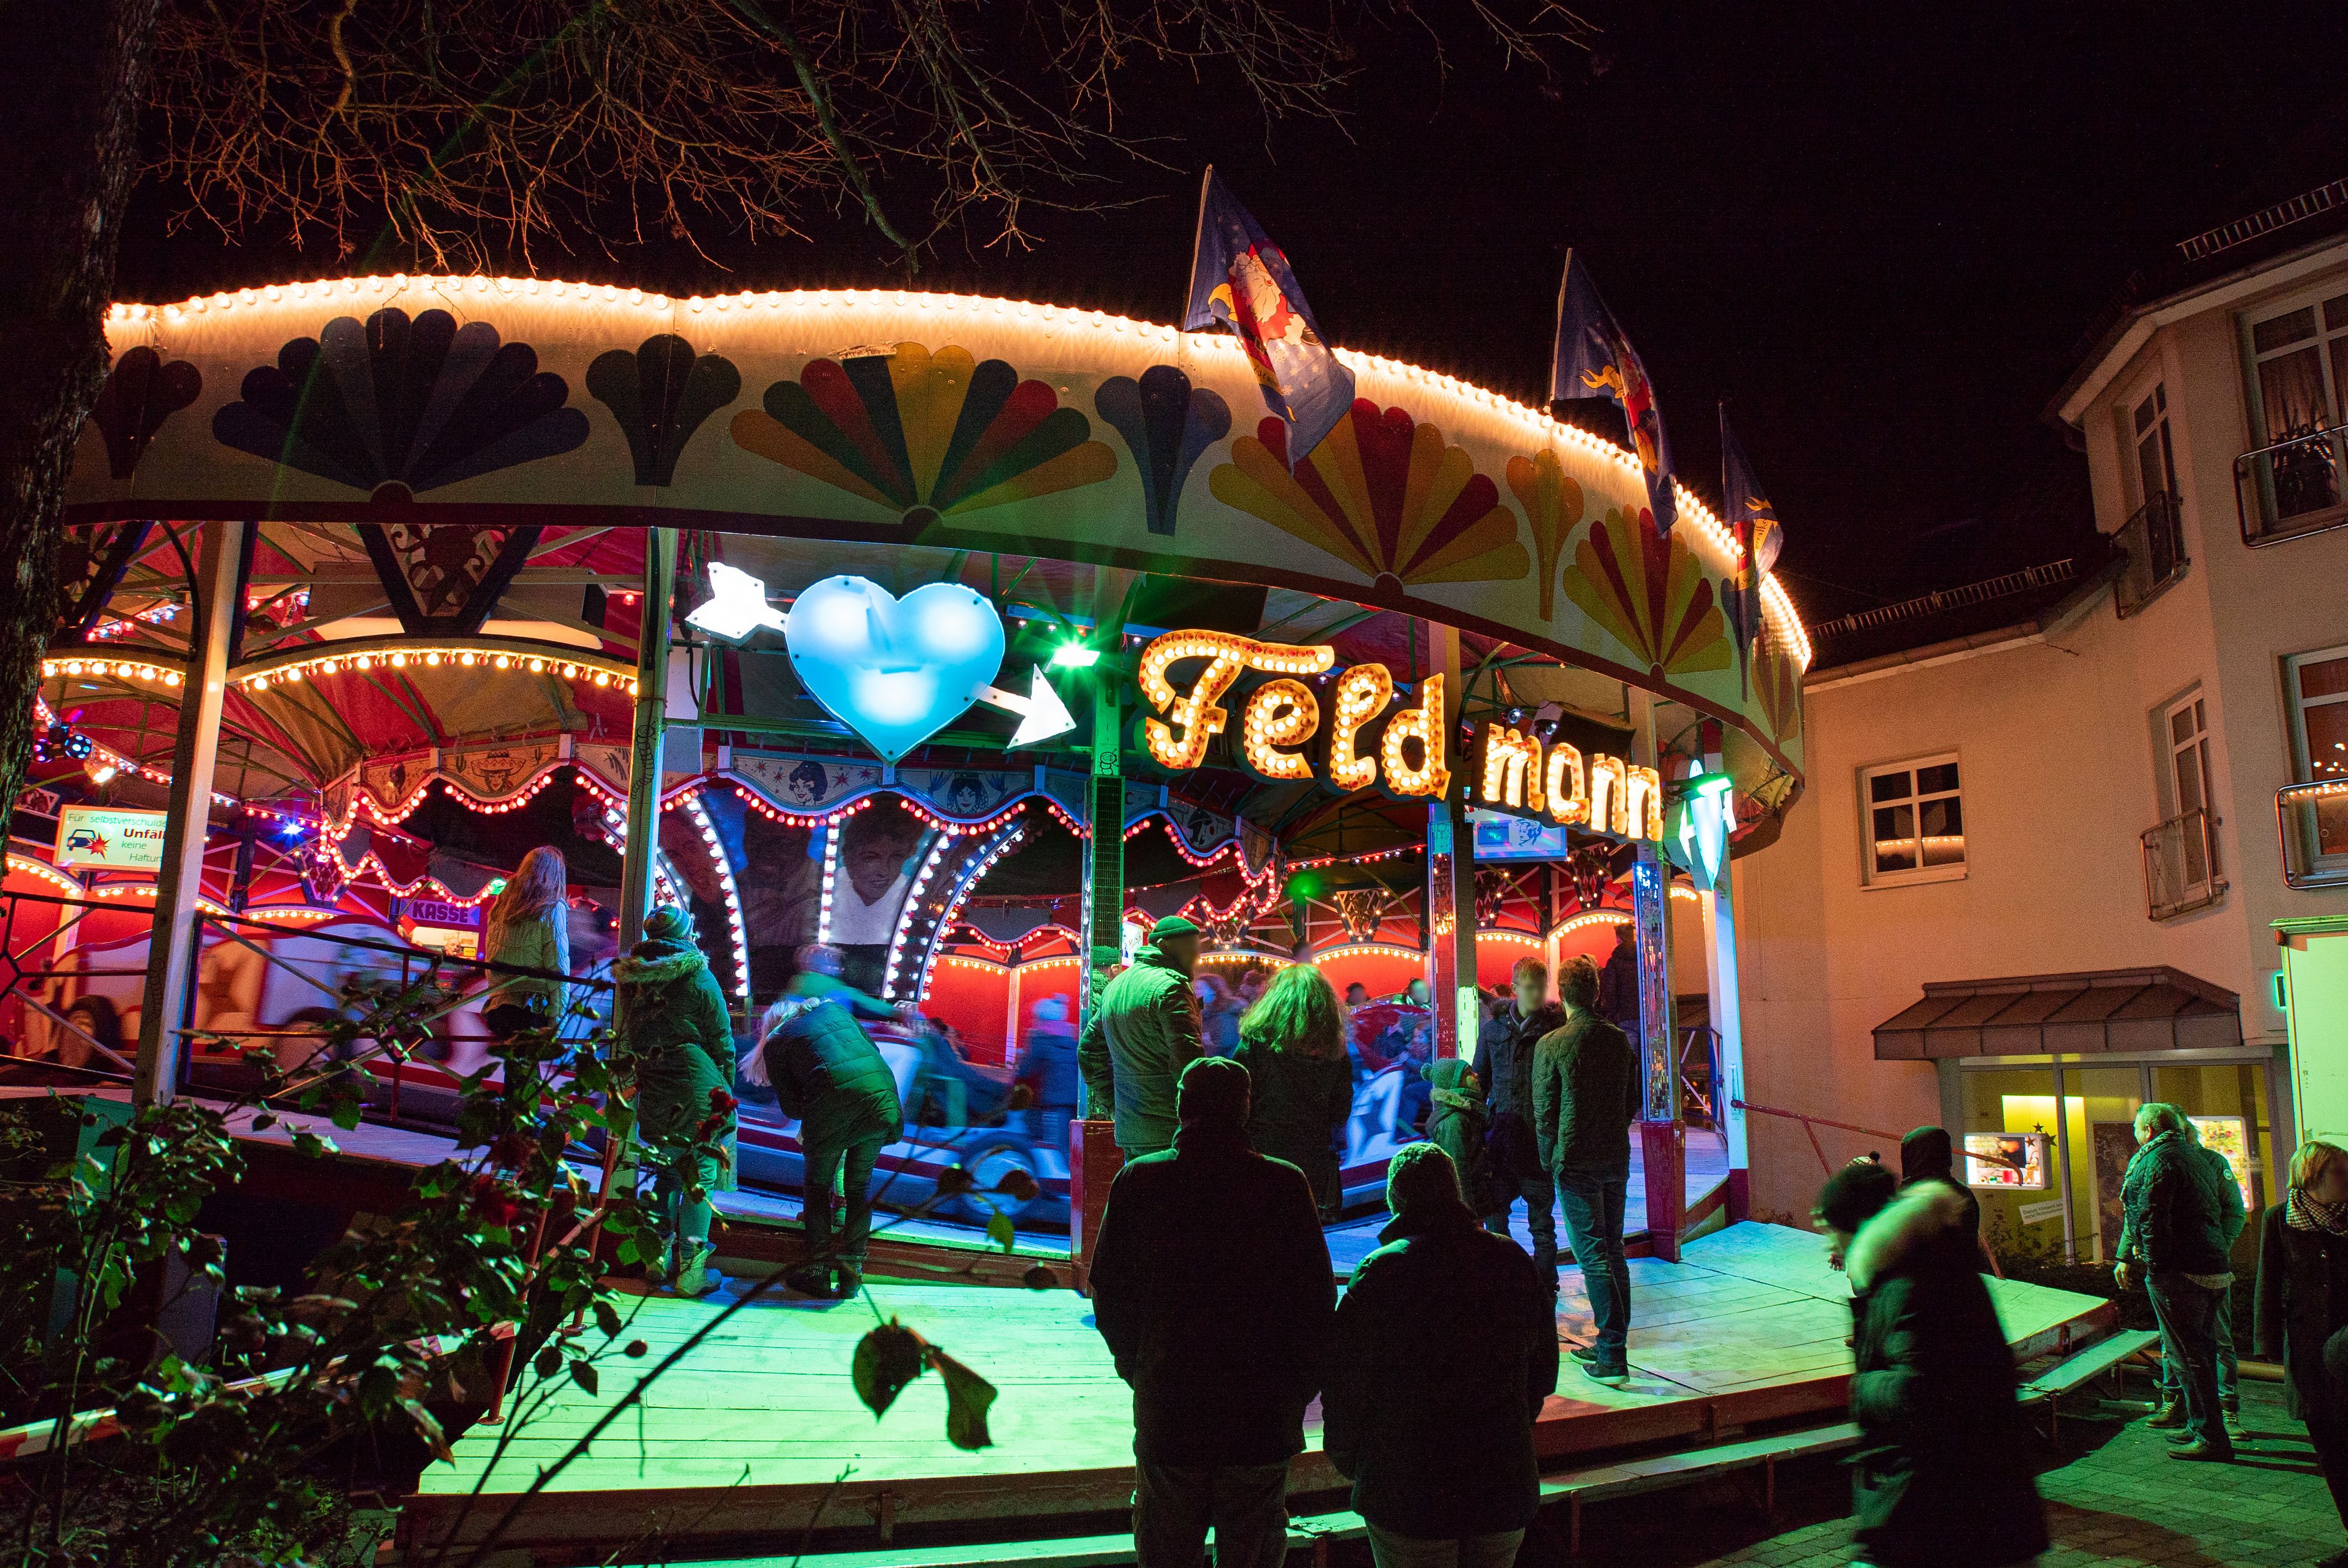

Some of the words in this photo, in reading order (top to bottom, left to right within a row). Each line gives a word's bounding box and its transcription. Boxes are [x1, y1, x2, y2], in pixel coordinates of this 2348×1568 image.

[1138, 629, 1451, 801] Feld
[1482, 723, 1664, 842] mann
[68, 813, 84, 822] Für
[121, 840, 147, 849] keine
[413, 901, 469, 923] KASSE
